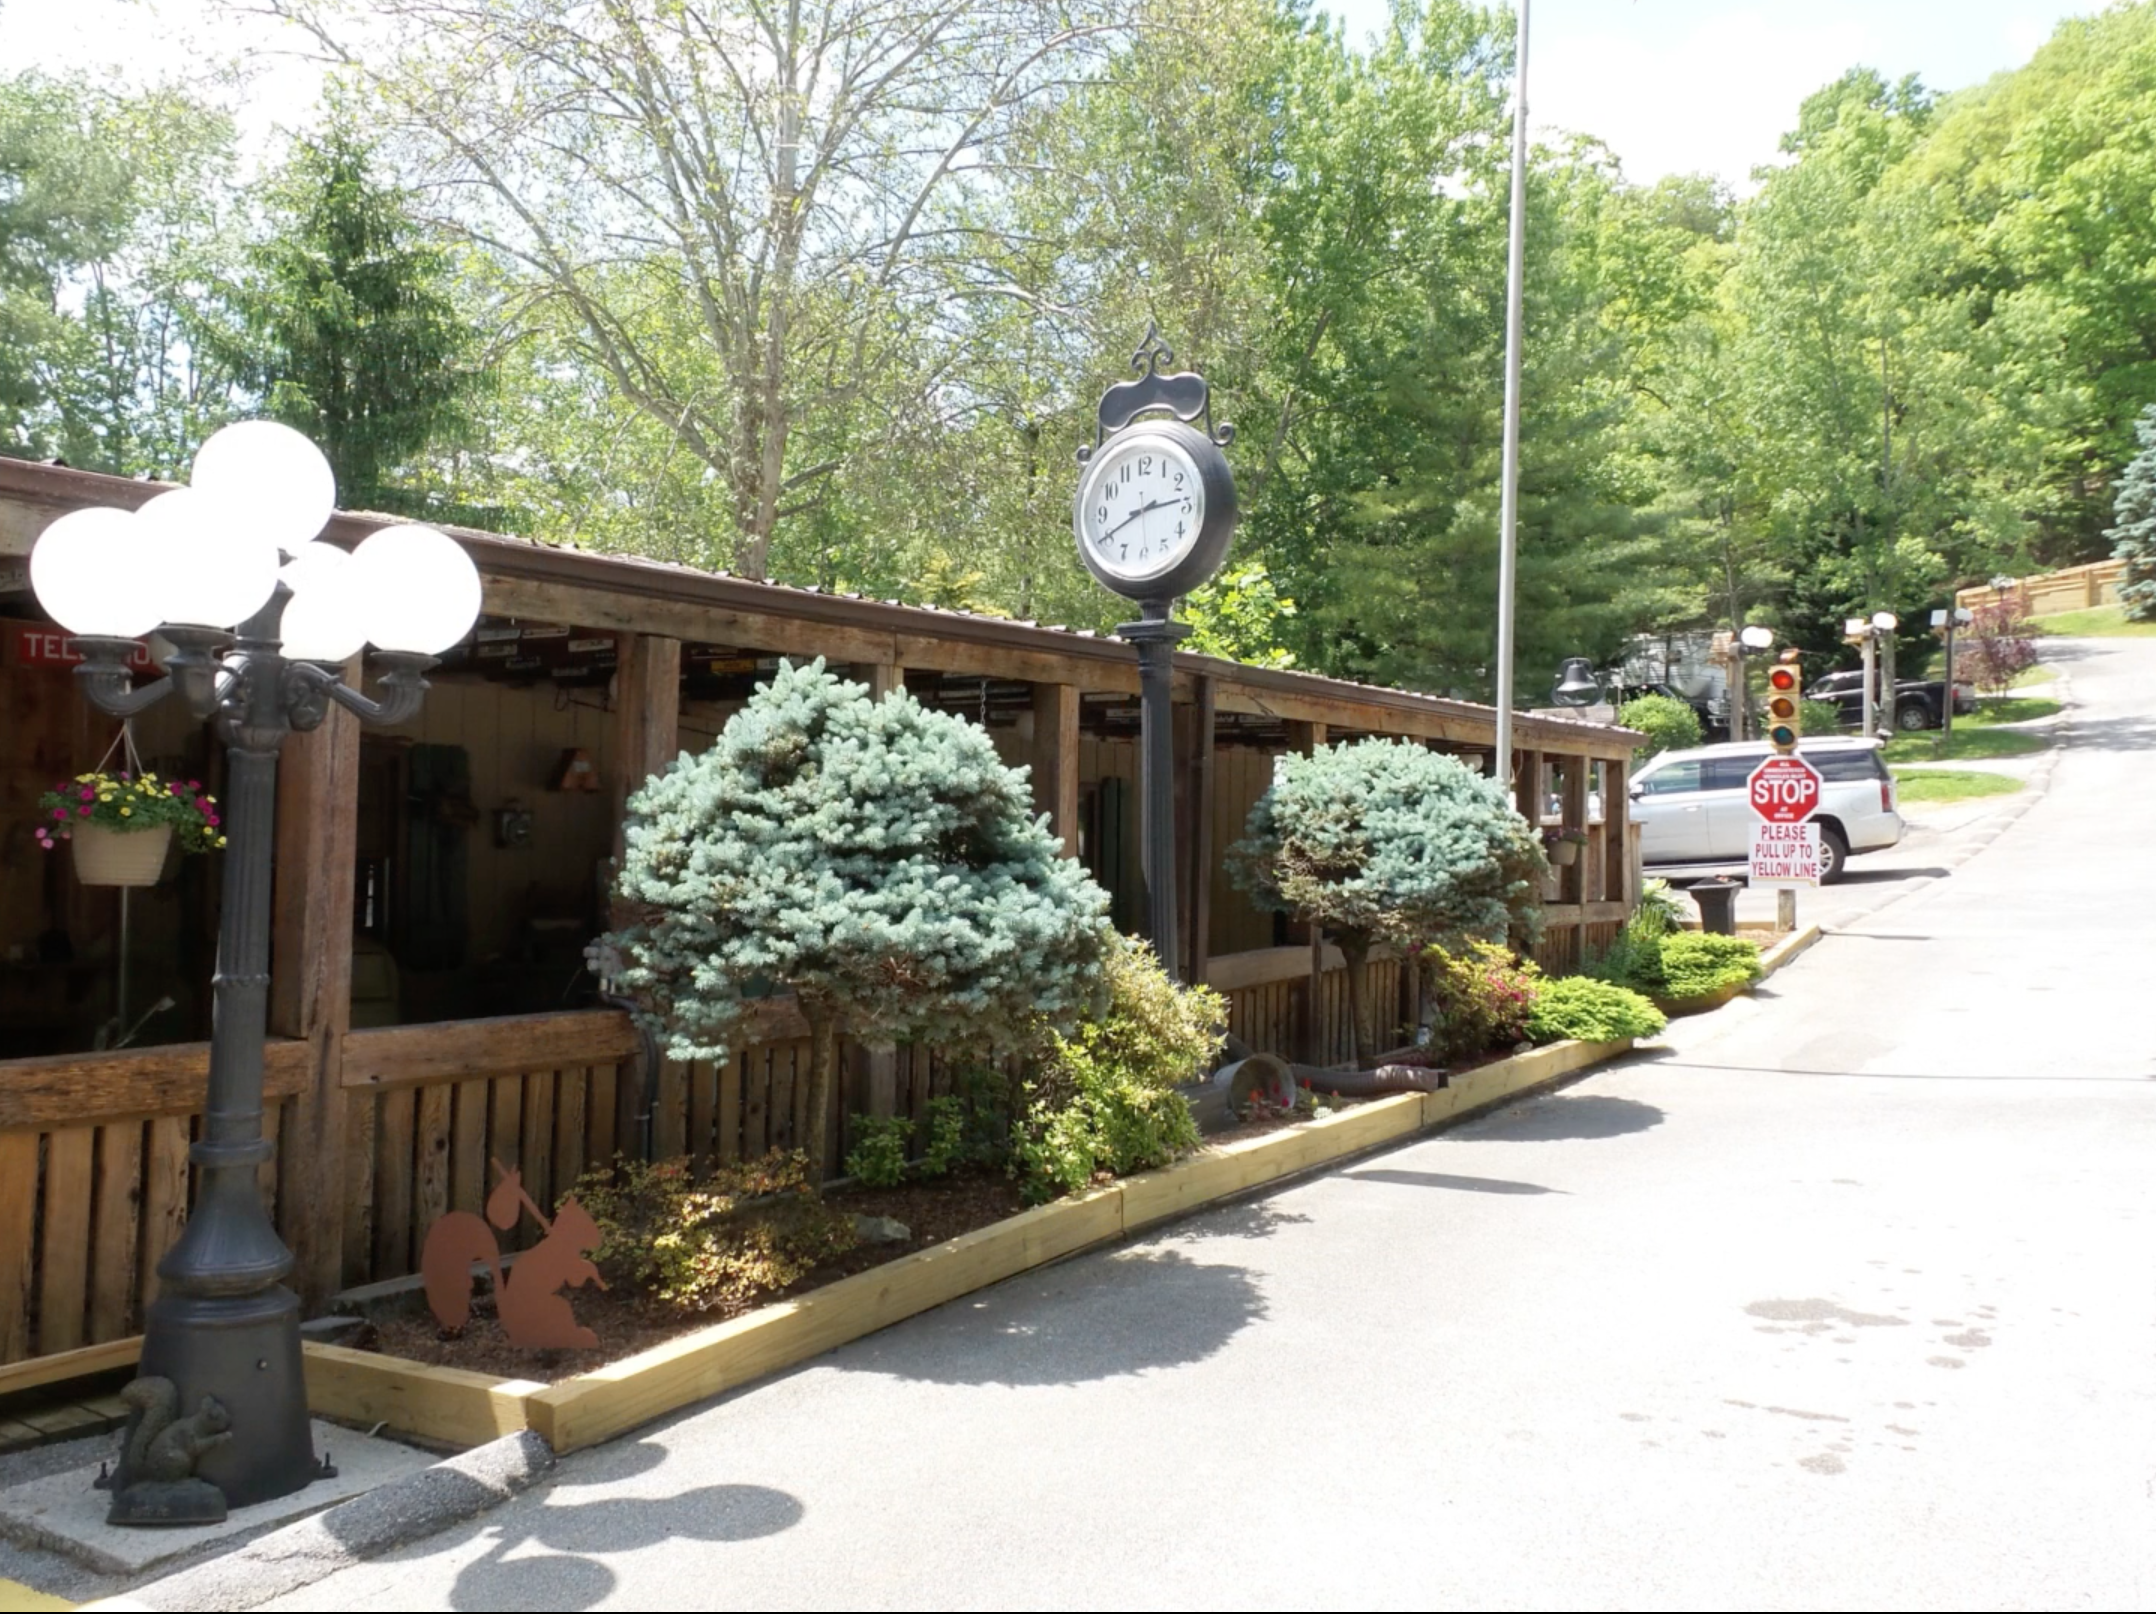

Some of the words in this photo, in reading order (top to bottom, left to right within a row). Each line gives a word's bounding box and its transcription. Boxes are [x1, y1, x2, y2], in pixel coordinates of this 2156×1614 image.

[1121, 464, 1130, 483] 11
[1138, 456, 1152, 476] 12
[1162, 460, 1167, 478] 1
[1174, 472, 1184, 491] 2
[1105, 481, 1119, 501] 10
[1181, 497, 1192, 514] 3
[1098, 506, 1108, 524] 9
[1105, 528, 1115, 547] 8
[1174, 520, 1185, 539] 4
[1120, 543, 1129, 561] 7
[1754, 779, 1816, 804] STOP
[1761, 825, 1806, 841] PLEASE
[1755, 843, 1780, 858] PULL
[1783, 844, 1796, 858] UP
[1799, 844, 1812, 859] TO
[1752, 861, 1791, 877] YELLOW
[1794, 862, 1817, 877] LINE
